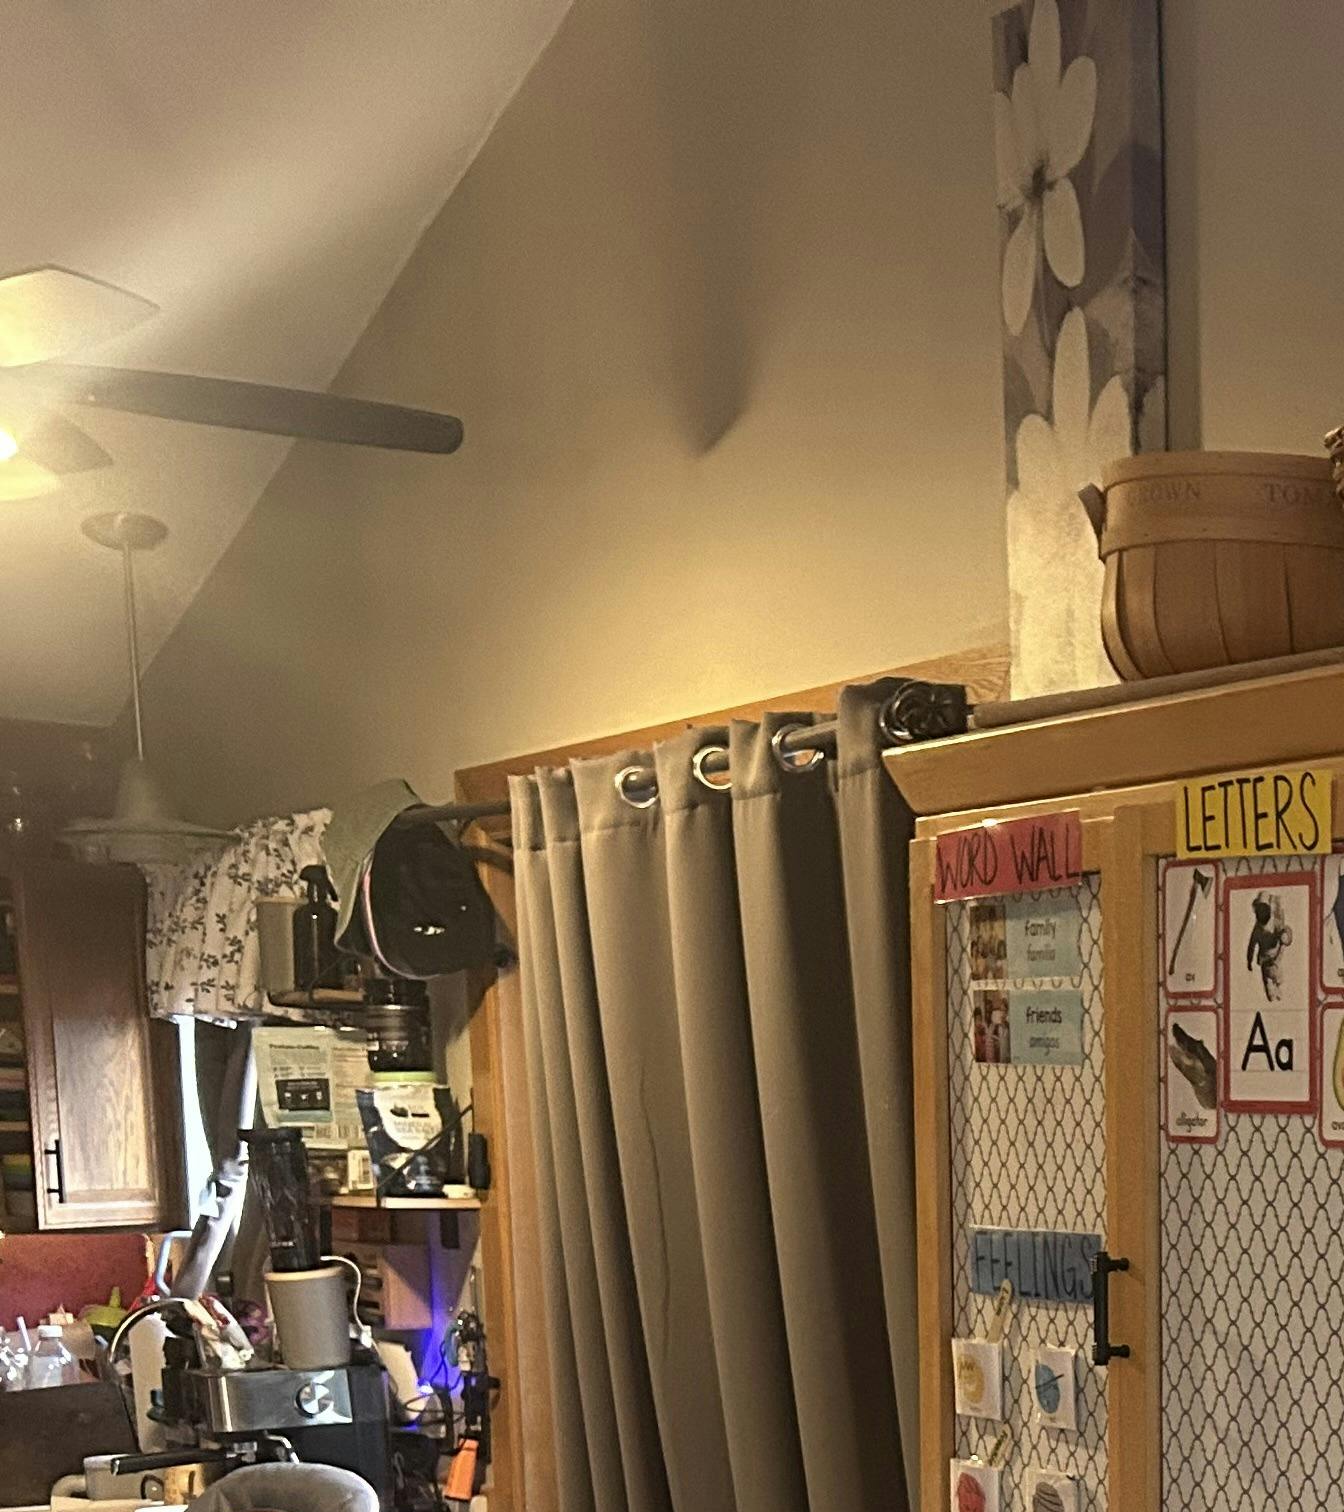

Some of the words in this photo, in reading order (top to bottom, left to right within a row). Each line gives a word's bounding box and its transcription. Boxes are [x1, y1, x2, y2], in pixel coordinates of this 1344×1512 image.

[1183, 771, 1321, 853] LETTERS
[936, 829, 998, 895] WORD
[1010, 823, 1081, 885] WALL
[1025, 918, 1057, 940] family
[1026, 1006, 1063, 1025] friends
[1241, 1011, 1294, 1072] Aa
[975, 1229, 1095, 1300] FEELINGS
